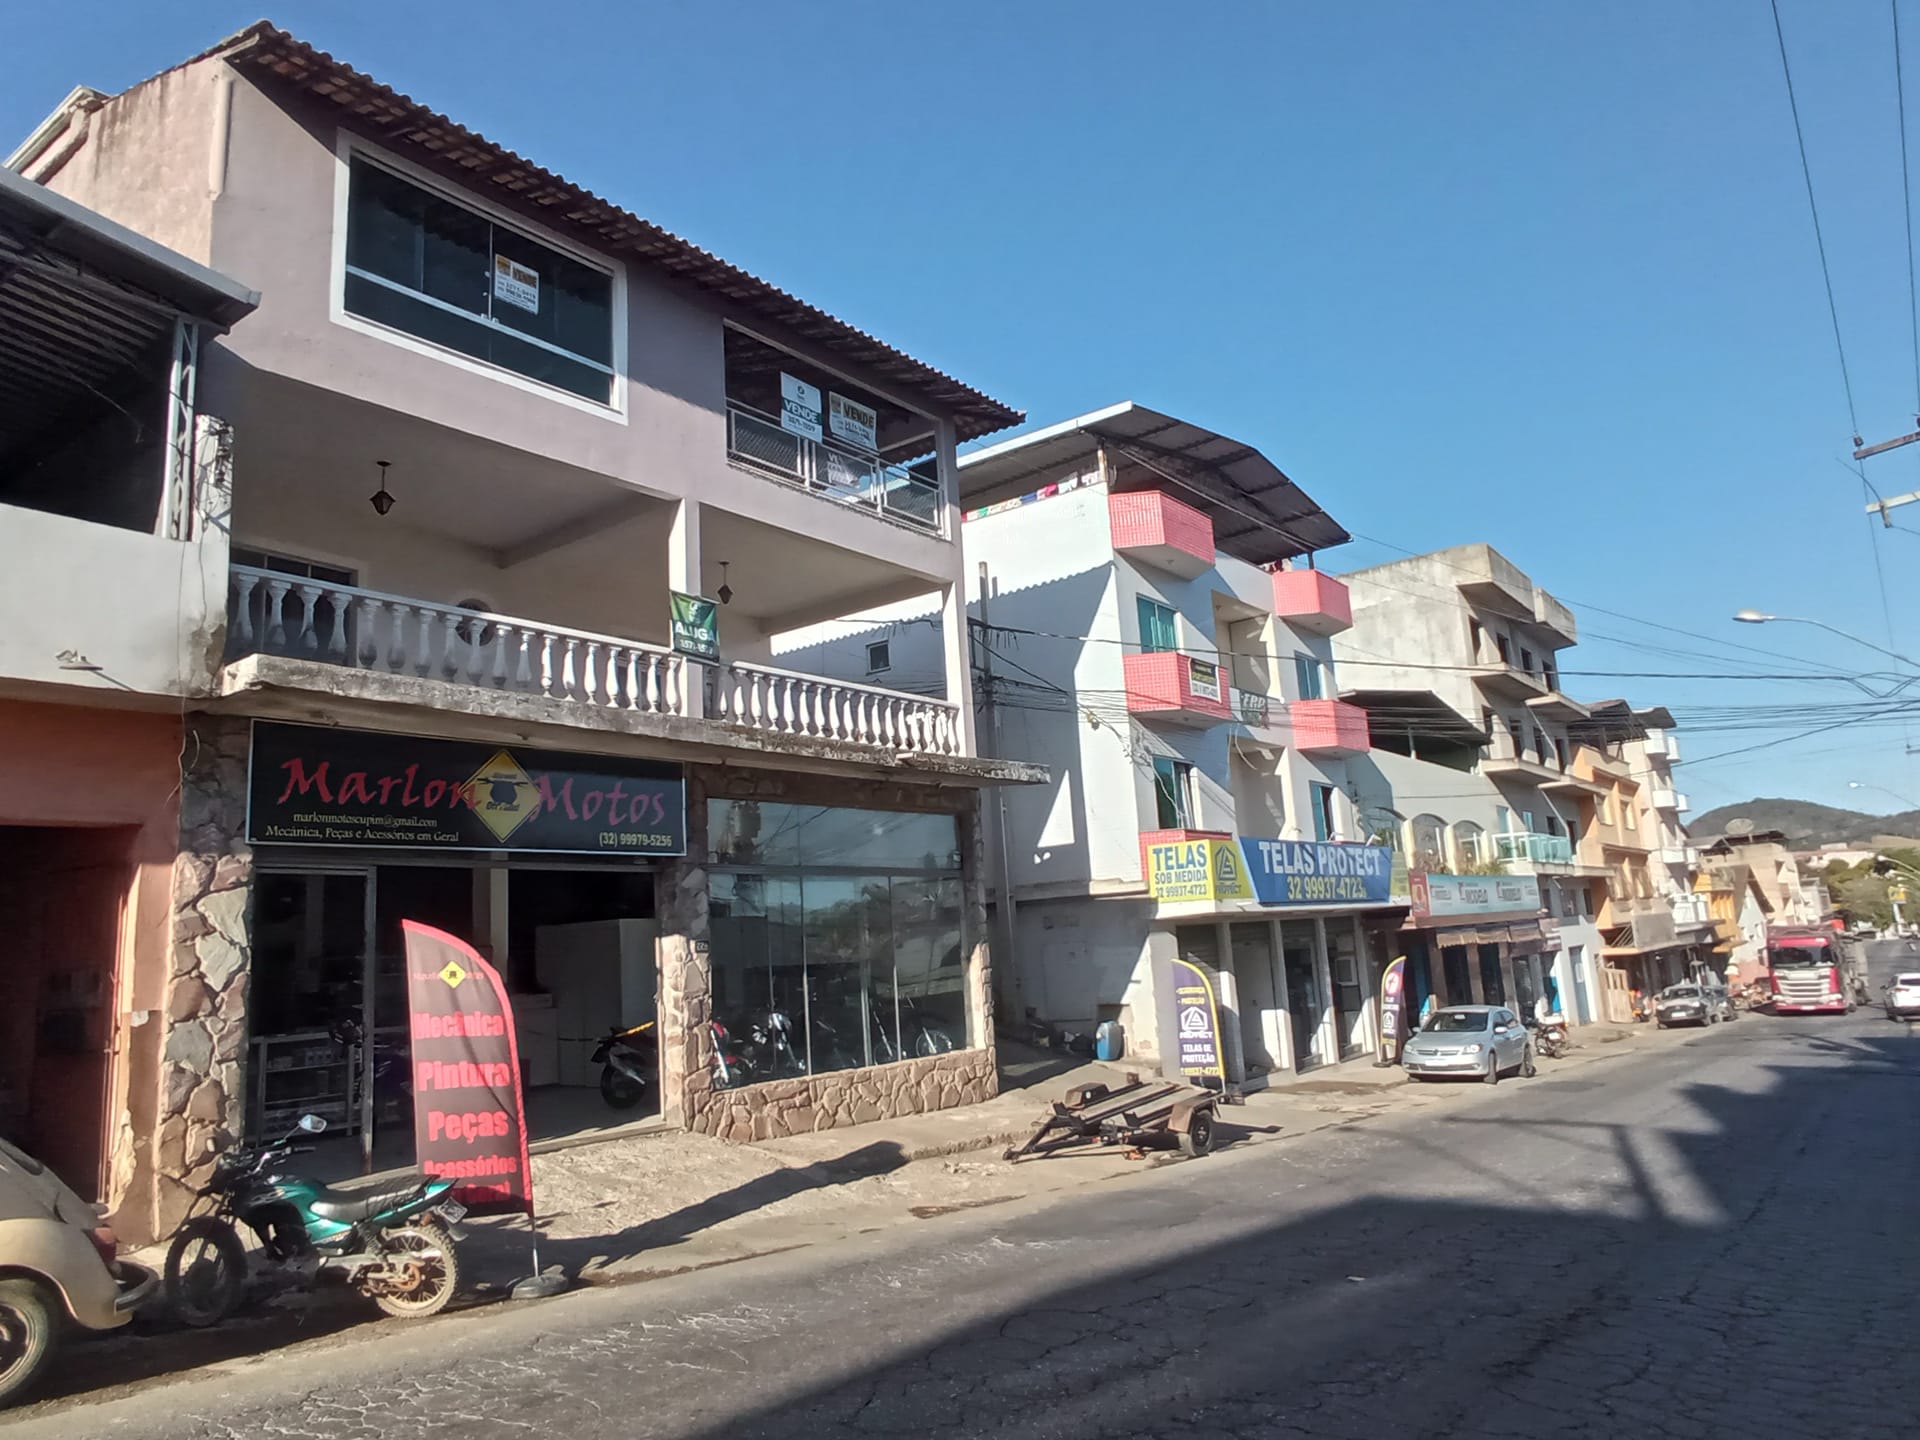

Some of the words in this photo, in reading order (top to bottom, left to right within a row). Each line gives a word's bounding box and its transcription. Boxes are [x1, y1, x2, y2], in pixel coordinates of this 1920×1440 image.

[784, 400, 818, 423] VENDE
[844, 402, 874, 427] VENDE
[277, 757, 481, 810] Marlon
[529, 775, 665, 826] Motos
[265, 825, 323, 839] Mecânica,
[325, 828, 353, 840] Peças
[417, 832, 432, 841] em
[434, 831, 459, 842] Geral
[600, 832, 618, 848] (32)
[1152, 844, 1207, 871] TELAS
[1258, 841, 1315, 875] TELAS
[1317, 845, 1381, 876] PROTECT
[1155, 872, 1172, 885] SOB
[1174, 869, 1208, 883] MEDIDA
[1287, 876, 1302, 899] 32
[1304, 876, 1366, 899] 99937-4723
[1166, 884, 1207, 898] 99937-4723
[413, 1011, 504, 1040] Mecânica
[1182, 1053, 1216, 1064] PROTEÇÃO
[1183, 1044, 1203, 1052] TELAS
[1203, 1044, 1213, 1052] DE
[417, 1061, 511, 1092] Pintura
[428, 1110, 509, 1143] Peças
[423, 1154, 517, 1178] Acessórios
